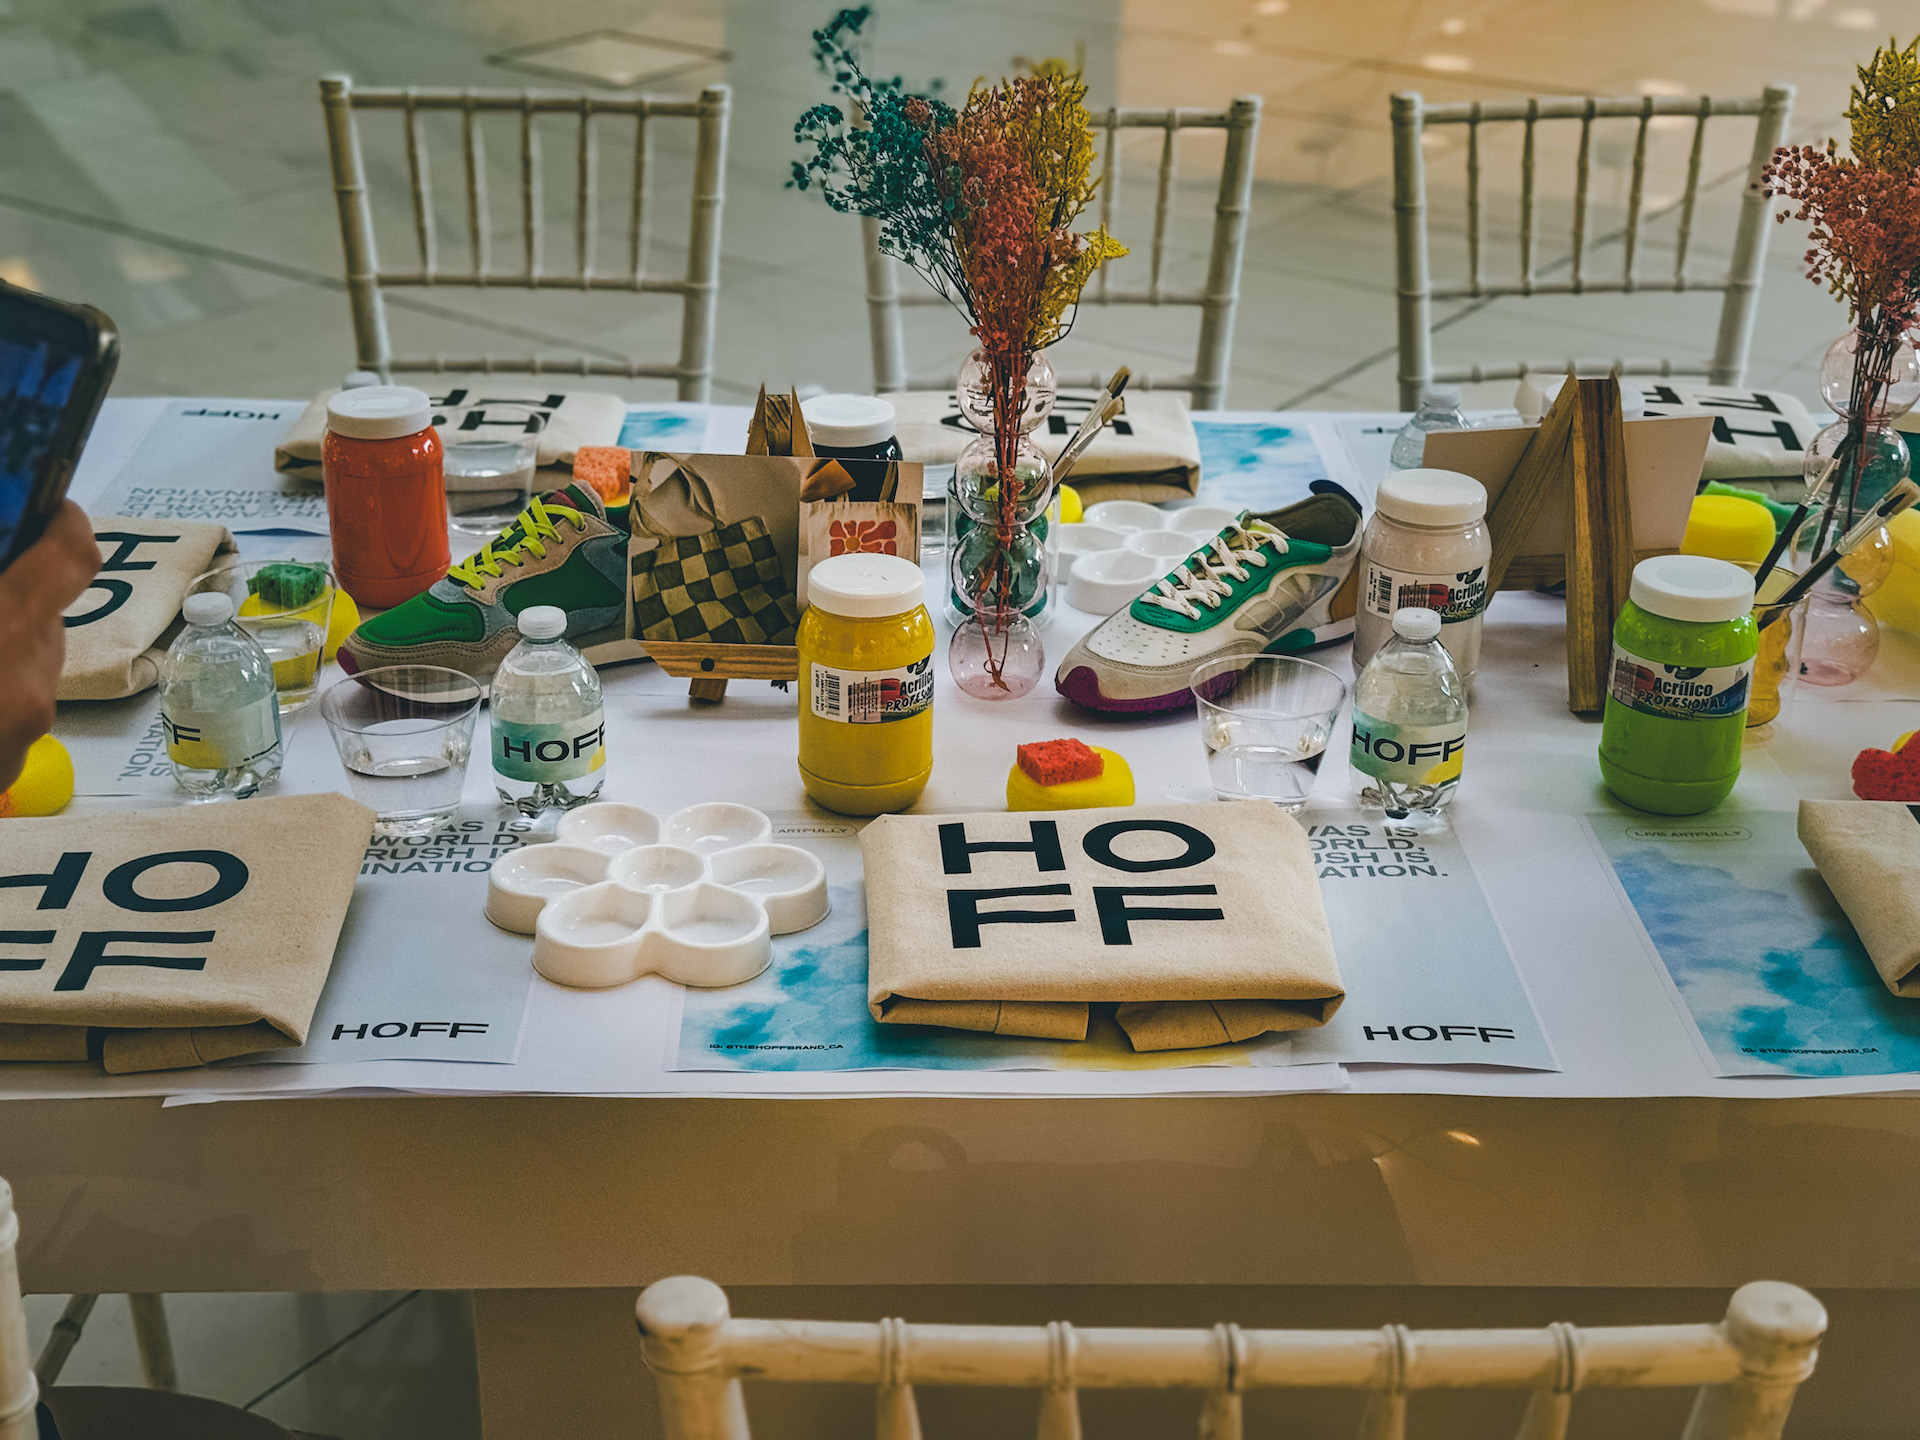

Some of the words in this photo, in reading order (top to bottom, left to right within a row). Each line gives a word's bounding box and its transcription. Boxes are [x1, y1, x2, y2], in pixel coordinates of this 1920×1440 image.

[181, 408, 281, 421] HOFF
[1653, 677, 1714, 697] Acrílico
[1637, 689, 1728, 711] PROFESIONAL
[1352, 723, 1466, 766] HOFF
[497, 821, 532, 832] IS
[1383, 826, 1420, 838] IS
[369, 834, 528, 847] WORLD,
[938, 819, 1217, 874] HO
[1394, 852, 1430, 864] IS
[1319, 865, 1449, 879] ATION.
[947, 883, 1225, 949] FF
[331, 1022, 490, 1041] HOFF
[1362, 1025, 1516, 1043] HOFF
